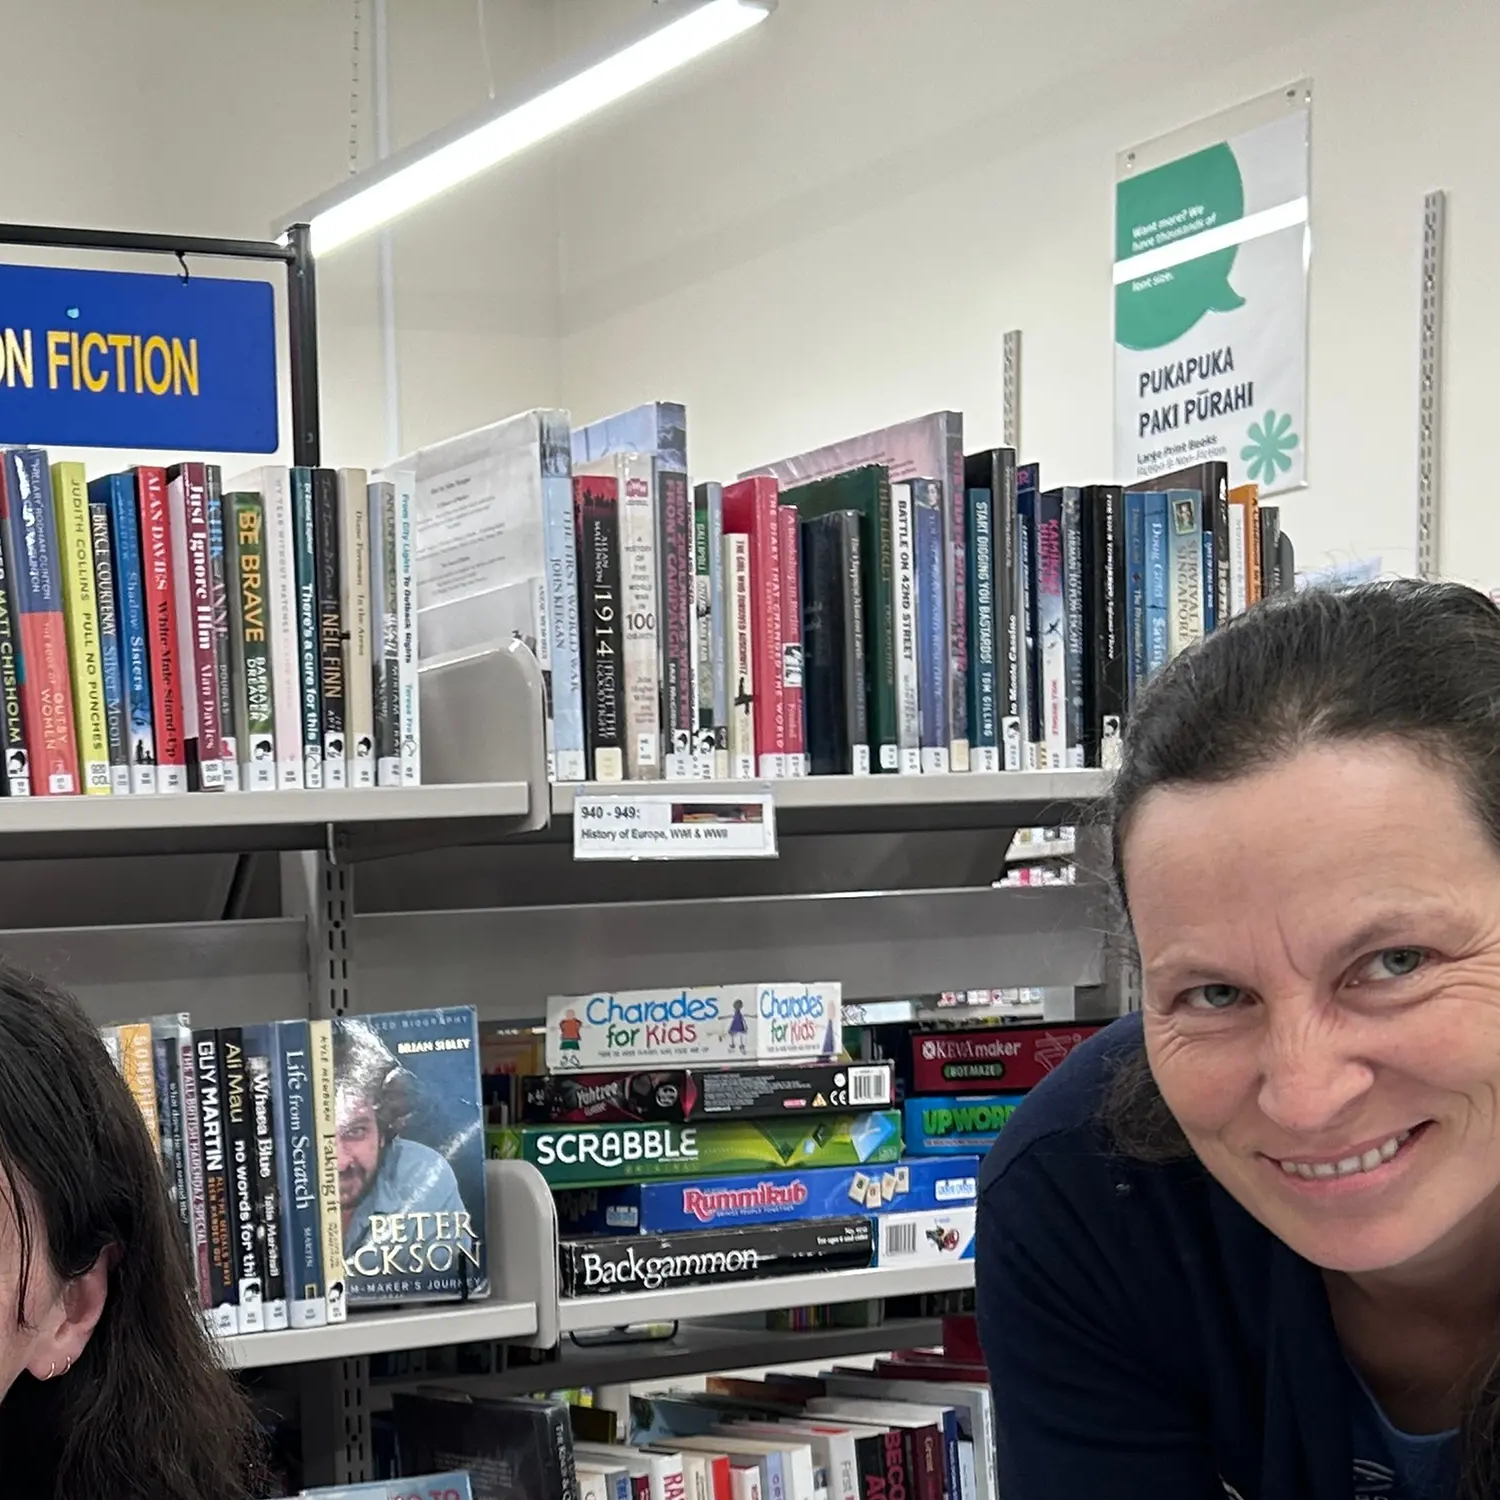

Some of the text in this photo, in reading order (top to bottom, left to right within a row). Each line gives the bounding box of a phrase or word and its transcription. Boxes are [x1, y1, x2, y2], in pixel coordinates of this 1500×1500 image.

[1132, 205, 1205, 238] Want more? We
[47, 330, 200, 396] FICTION
[1139, 346, 1235, 398] PUKAPUKA
[1138, 381, 1255, 438] PAKI PŪRAHI
[1136, 451, 1160, 466] Large
[1184, 436, 1218, 451] Books
[239, 512, 264, 642] BE BRAVE
[553, 557, 566, 651] JOHN KEEGAN
[594, 591, 615, 664] 1914
[0, 640, 21, 743] CHISHOLM
[40, 687, 57, 750] WOMEN
[581, 806, 603, 819] 940
[614, 807, 640, 820] 949:
[581, 829, 616, 842] History
[619, 829, 629, 839] of
[631, 829, 668, 844] Europe,
[586, 991, 719, 1026] Charades
[759, 990, 824, 1020] Charades
[397, 1038, 471, 1054] BRIAN SIBLEY
[606, 1022, 697, 1048] for Kids
[770, 1018, 817, 1043] for Kids
[949, 1065, 996, 1077] BOT MAZE
[197, 1040, 223, 1171] GUY MARTIN
[536, 1128, 700, 1168] SCRABBLE
[682, 1179, 809, 1222] Rummikub
[368, 1211, 478, 1243] PETER
[581, 1246, 759, 1291] Backgammon
